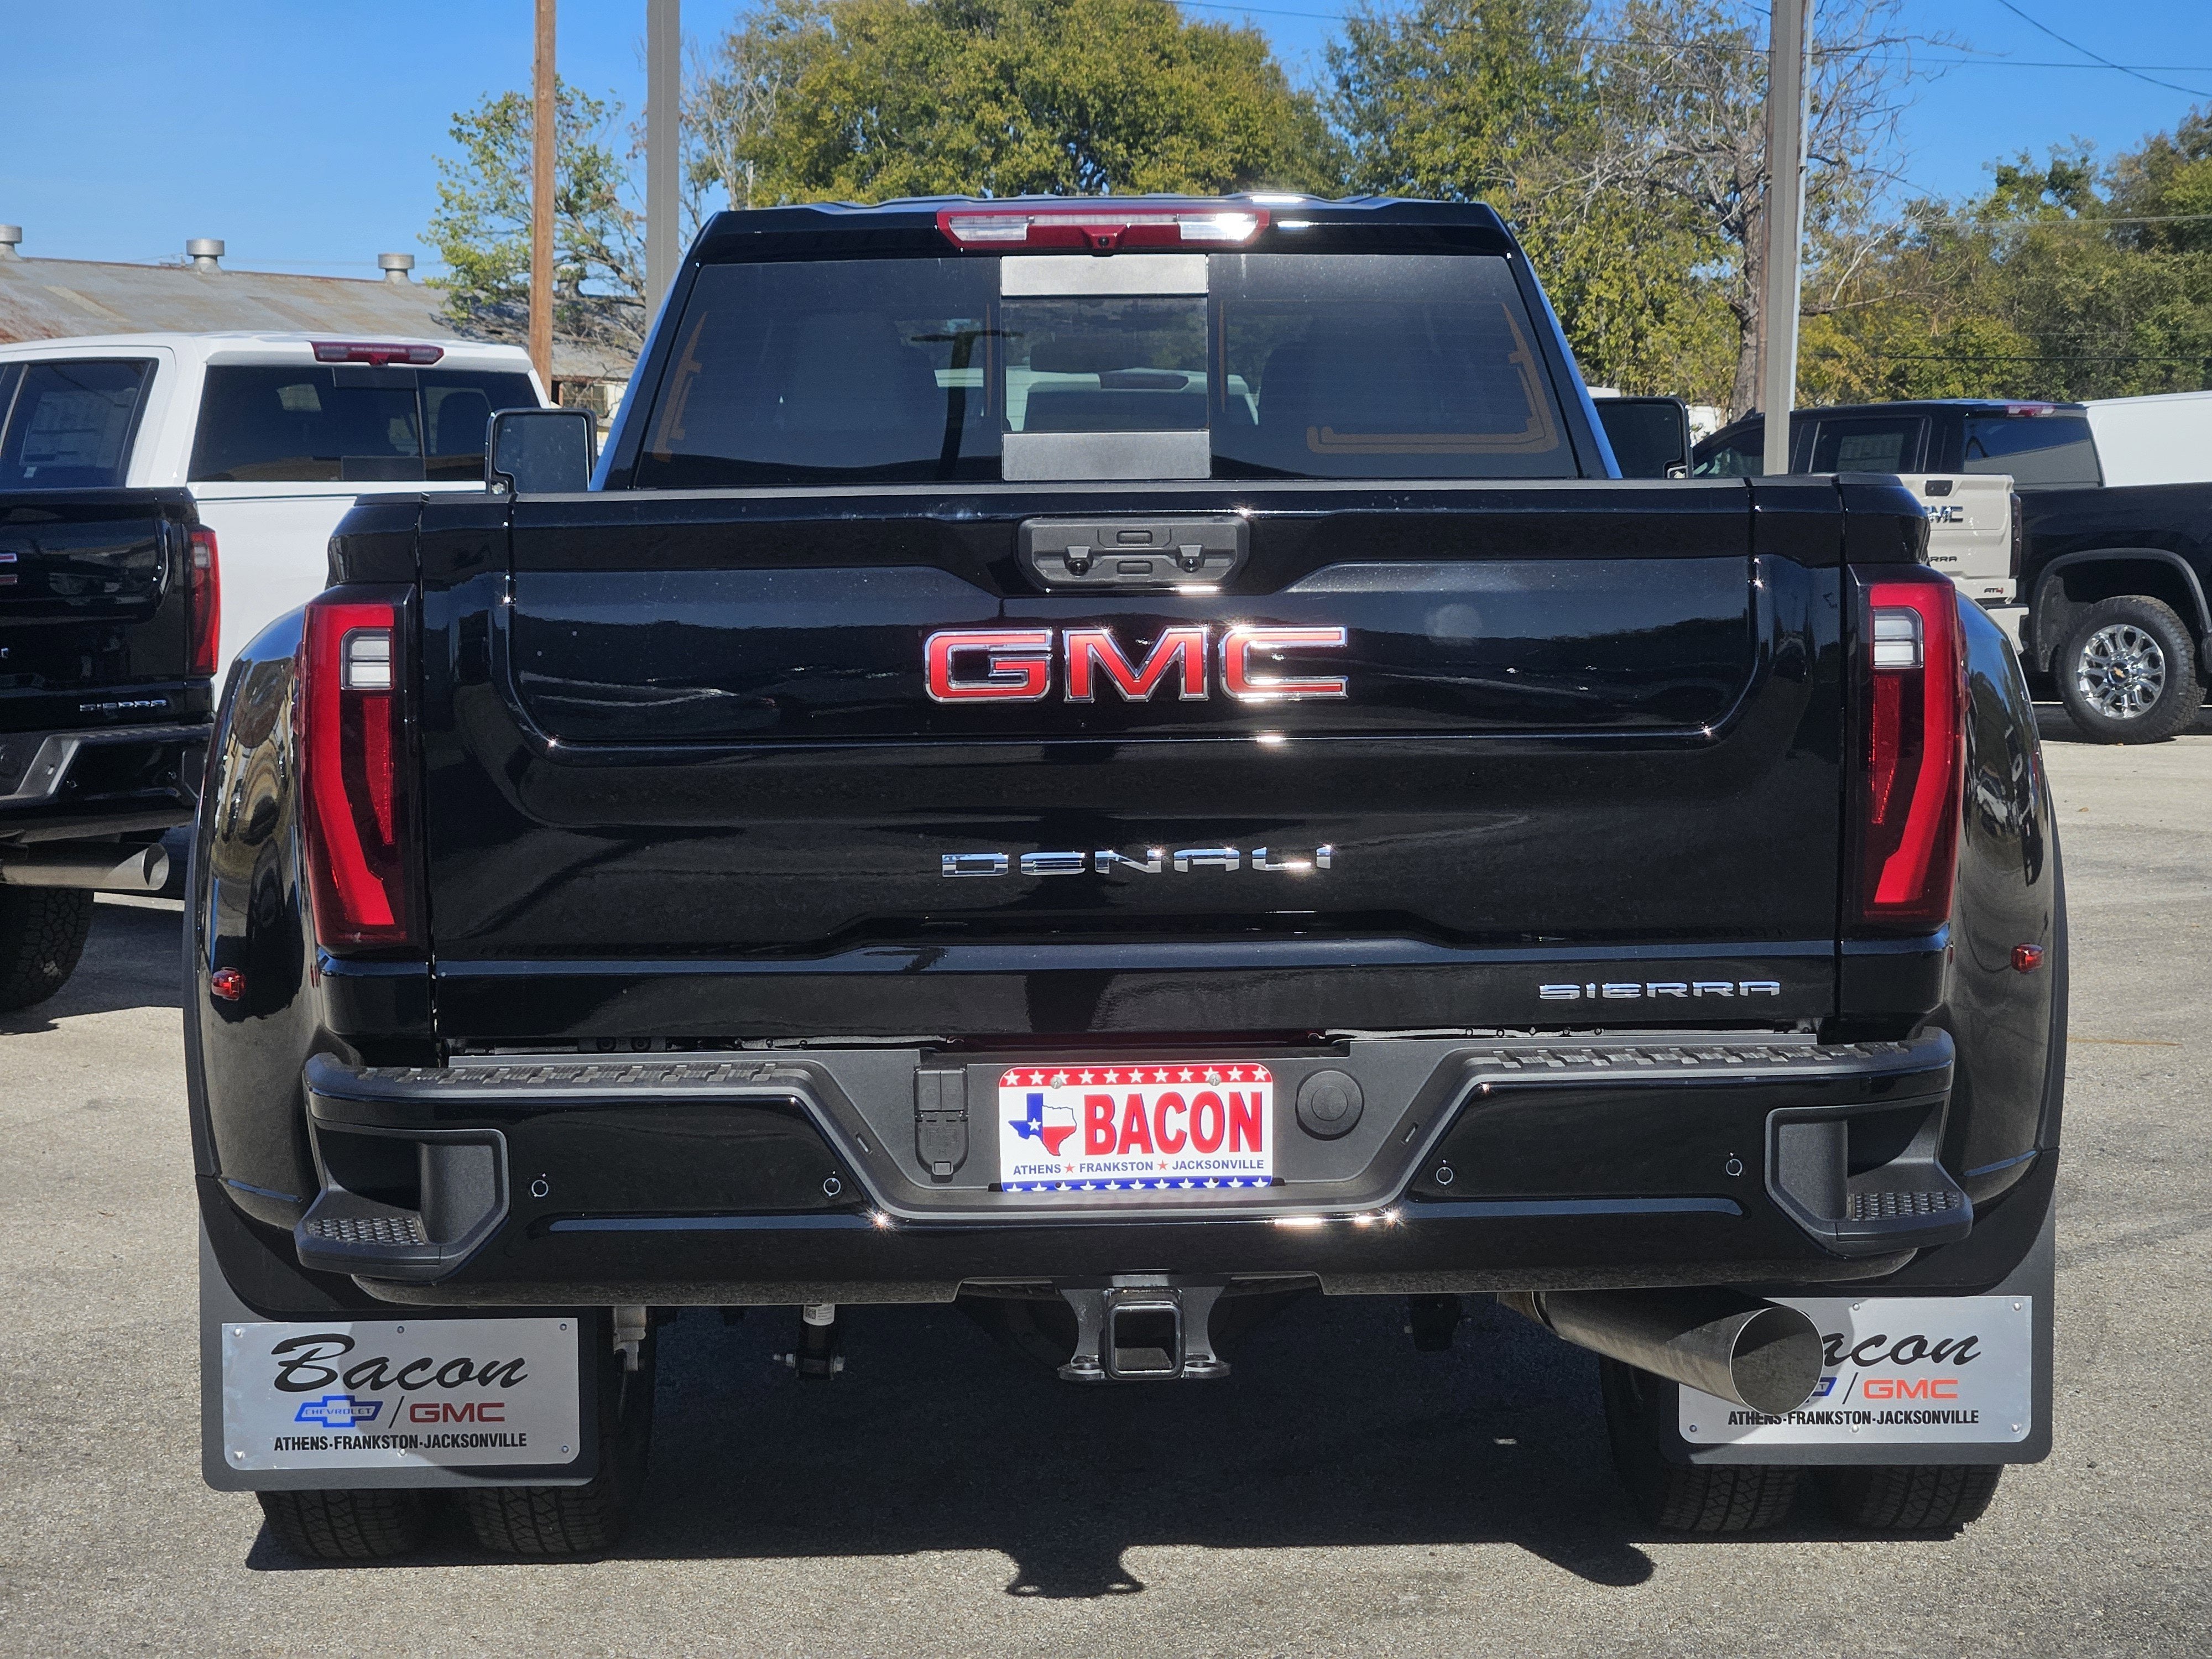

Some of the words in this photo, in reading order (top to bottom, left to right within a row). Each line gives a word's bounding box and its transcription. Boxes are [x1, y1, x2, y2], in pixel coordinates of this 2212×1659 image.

[924, 625, 1349, 705] GMC
[942, 846, 1331, 878] DENALI
[1539, 981, 1780, 999] SIERRA
[1084, 1091, 1263, 1156] BACON
[1013, 1164, 1062, 1175] ATHENS
[1079, 1161, 1154, 1172] FRANKSTON
[1171, 1159, 1264, 1171] JACKSONVILLE
[271, 1333, 528, 1392] Bacon
[1863, 1379, 1958, 1399] GMC
[409, 1402, 505, 1423] GMC
